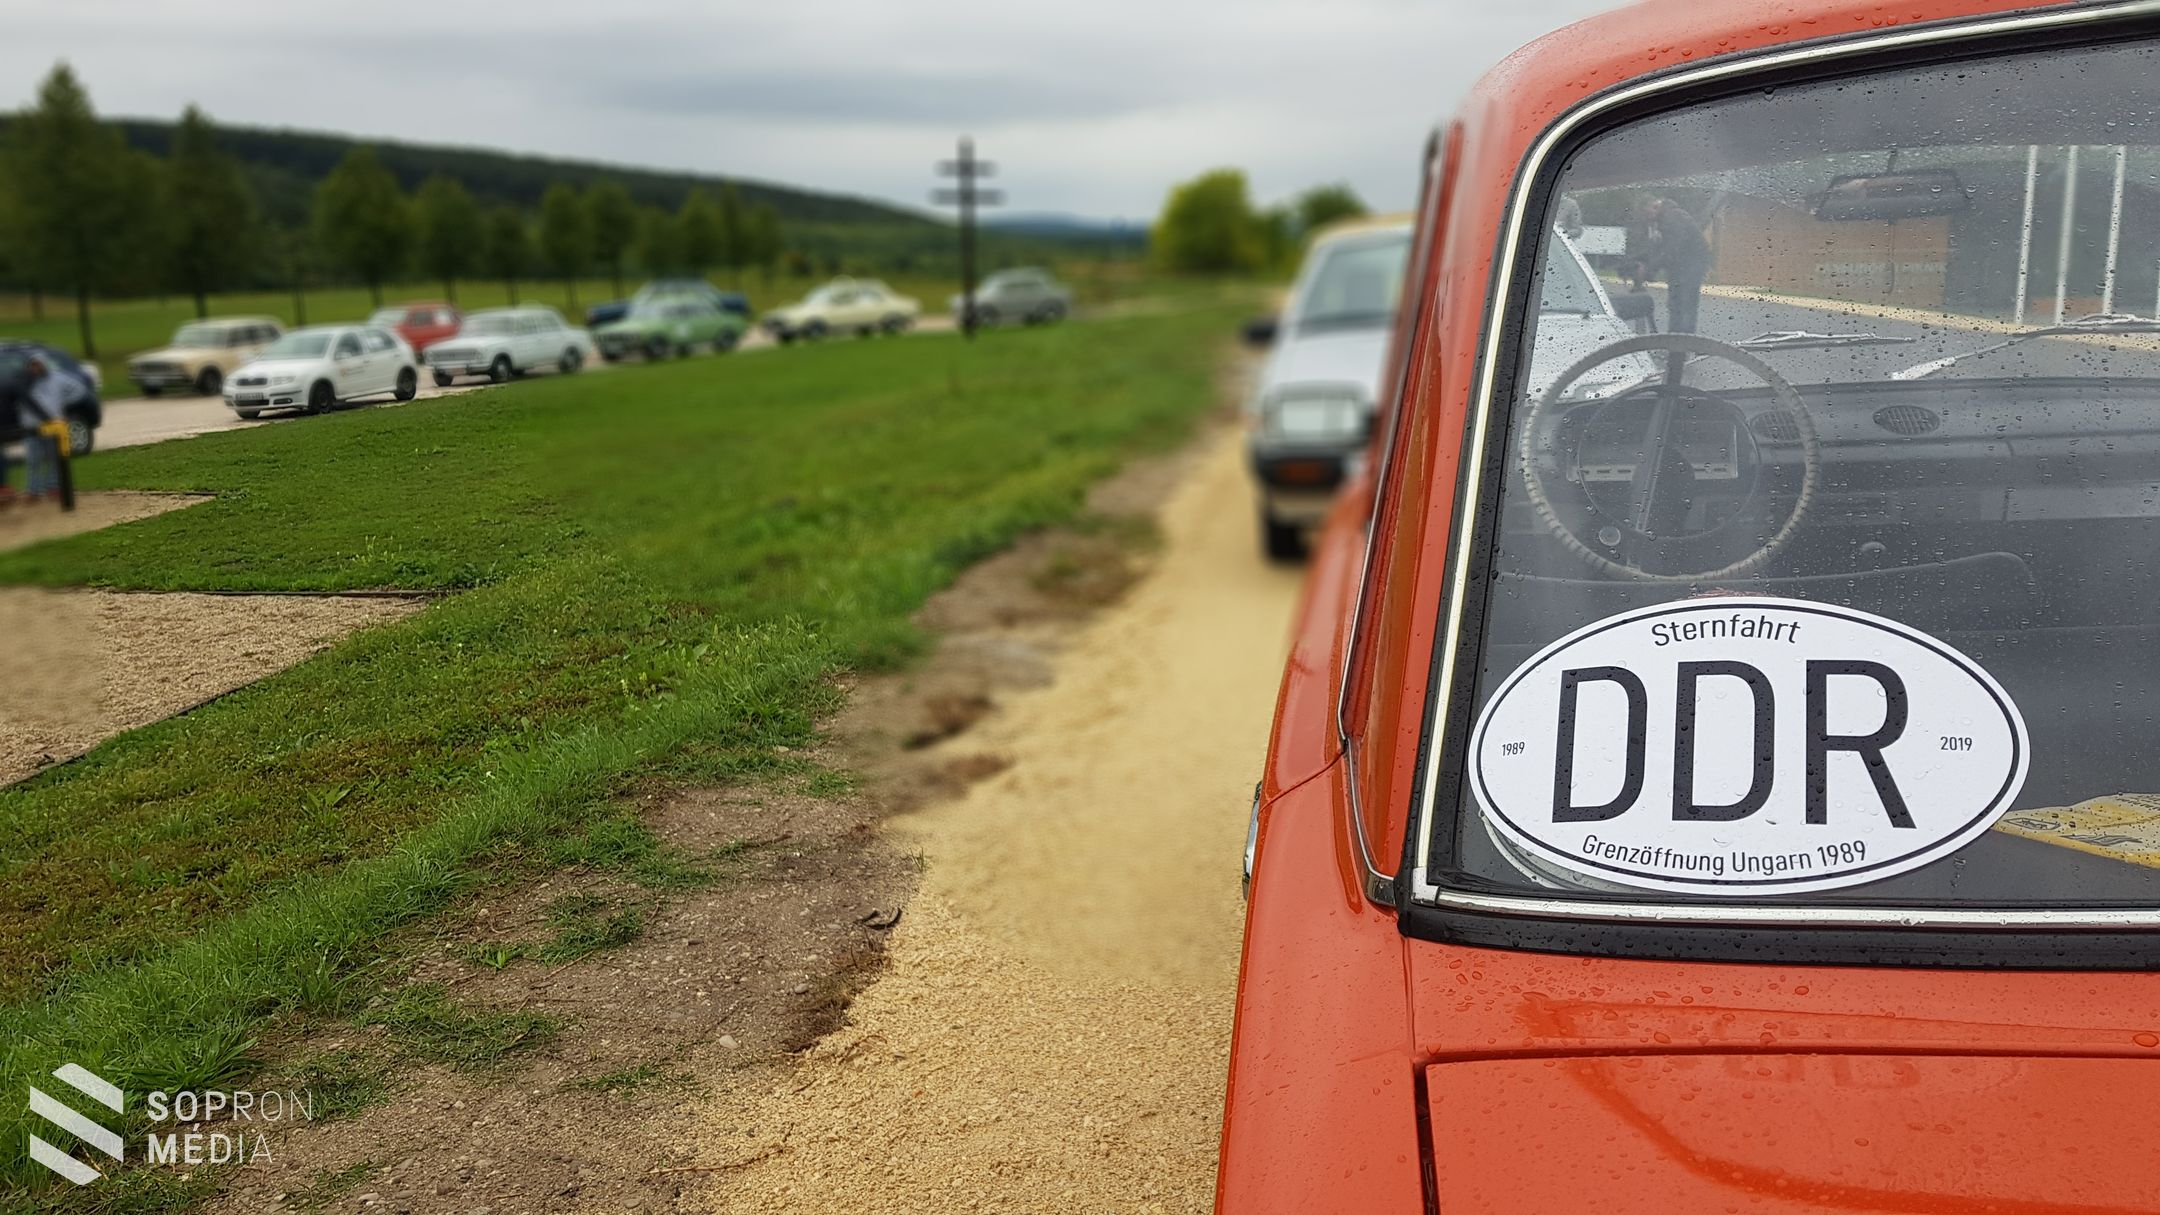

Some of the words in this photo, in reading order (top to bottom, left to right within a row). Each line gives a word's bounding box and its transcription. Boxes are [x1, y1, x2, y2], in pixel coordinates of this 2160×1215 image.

[1651, 613, 1802, 648] Sternfahrt
[1501, 741, 1525, 757] 1989
[1551, 659, 1917, 830] DDR
[1939, 735, 1973, 752] 2019
[1581, 834, 1724, 876] Grenzöffnung
[1732, 851, 1812, 875] Ungarn
[1817, 839, 1866, 868] 1989
